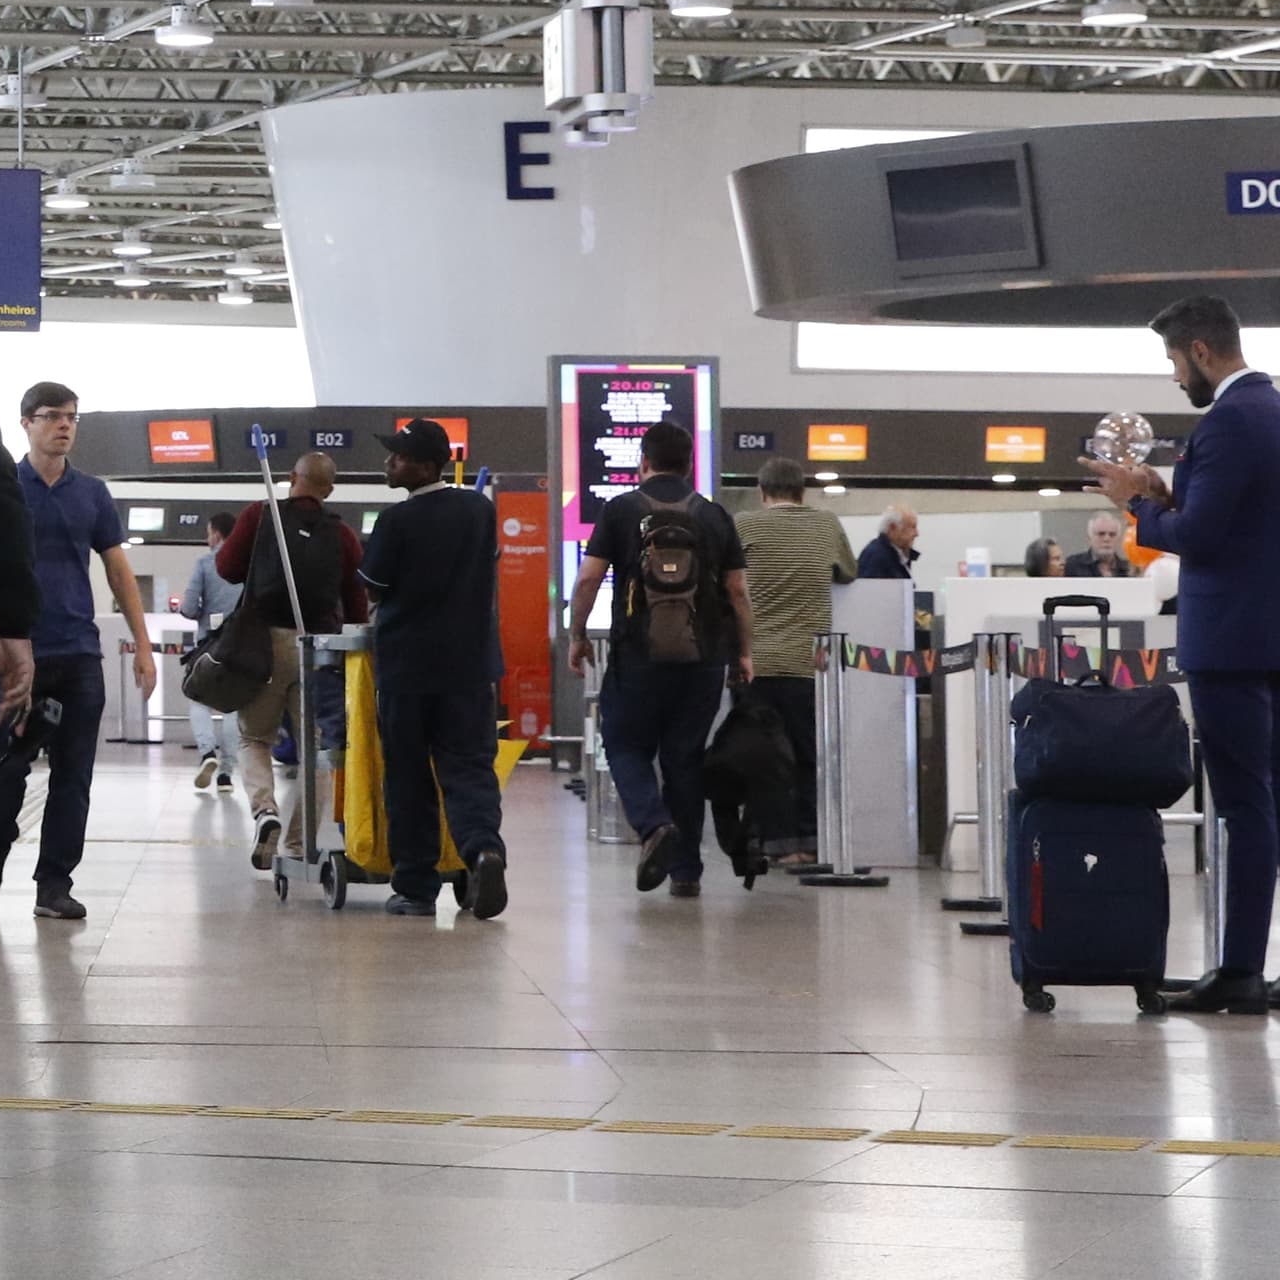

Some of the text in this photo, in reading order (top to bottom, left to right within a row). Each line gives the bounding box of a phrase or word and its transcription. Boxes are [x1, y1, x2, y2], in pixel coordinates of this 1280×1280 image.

[503, 120, 555, 201] E
[315, 432, 345, 447] E02
[738, 433, 766, 449] E04
[608, 472, 639, 484] 22.1
